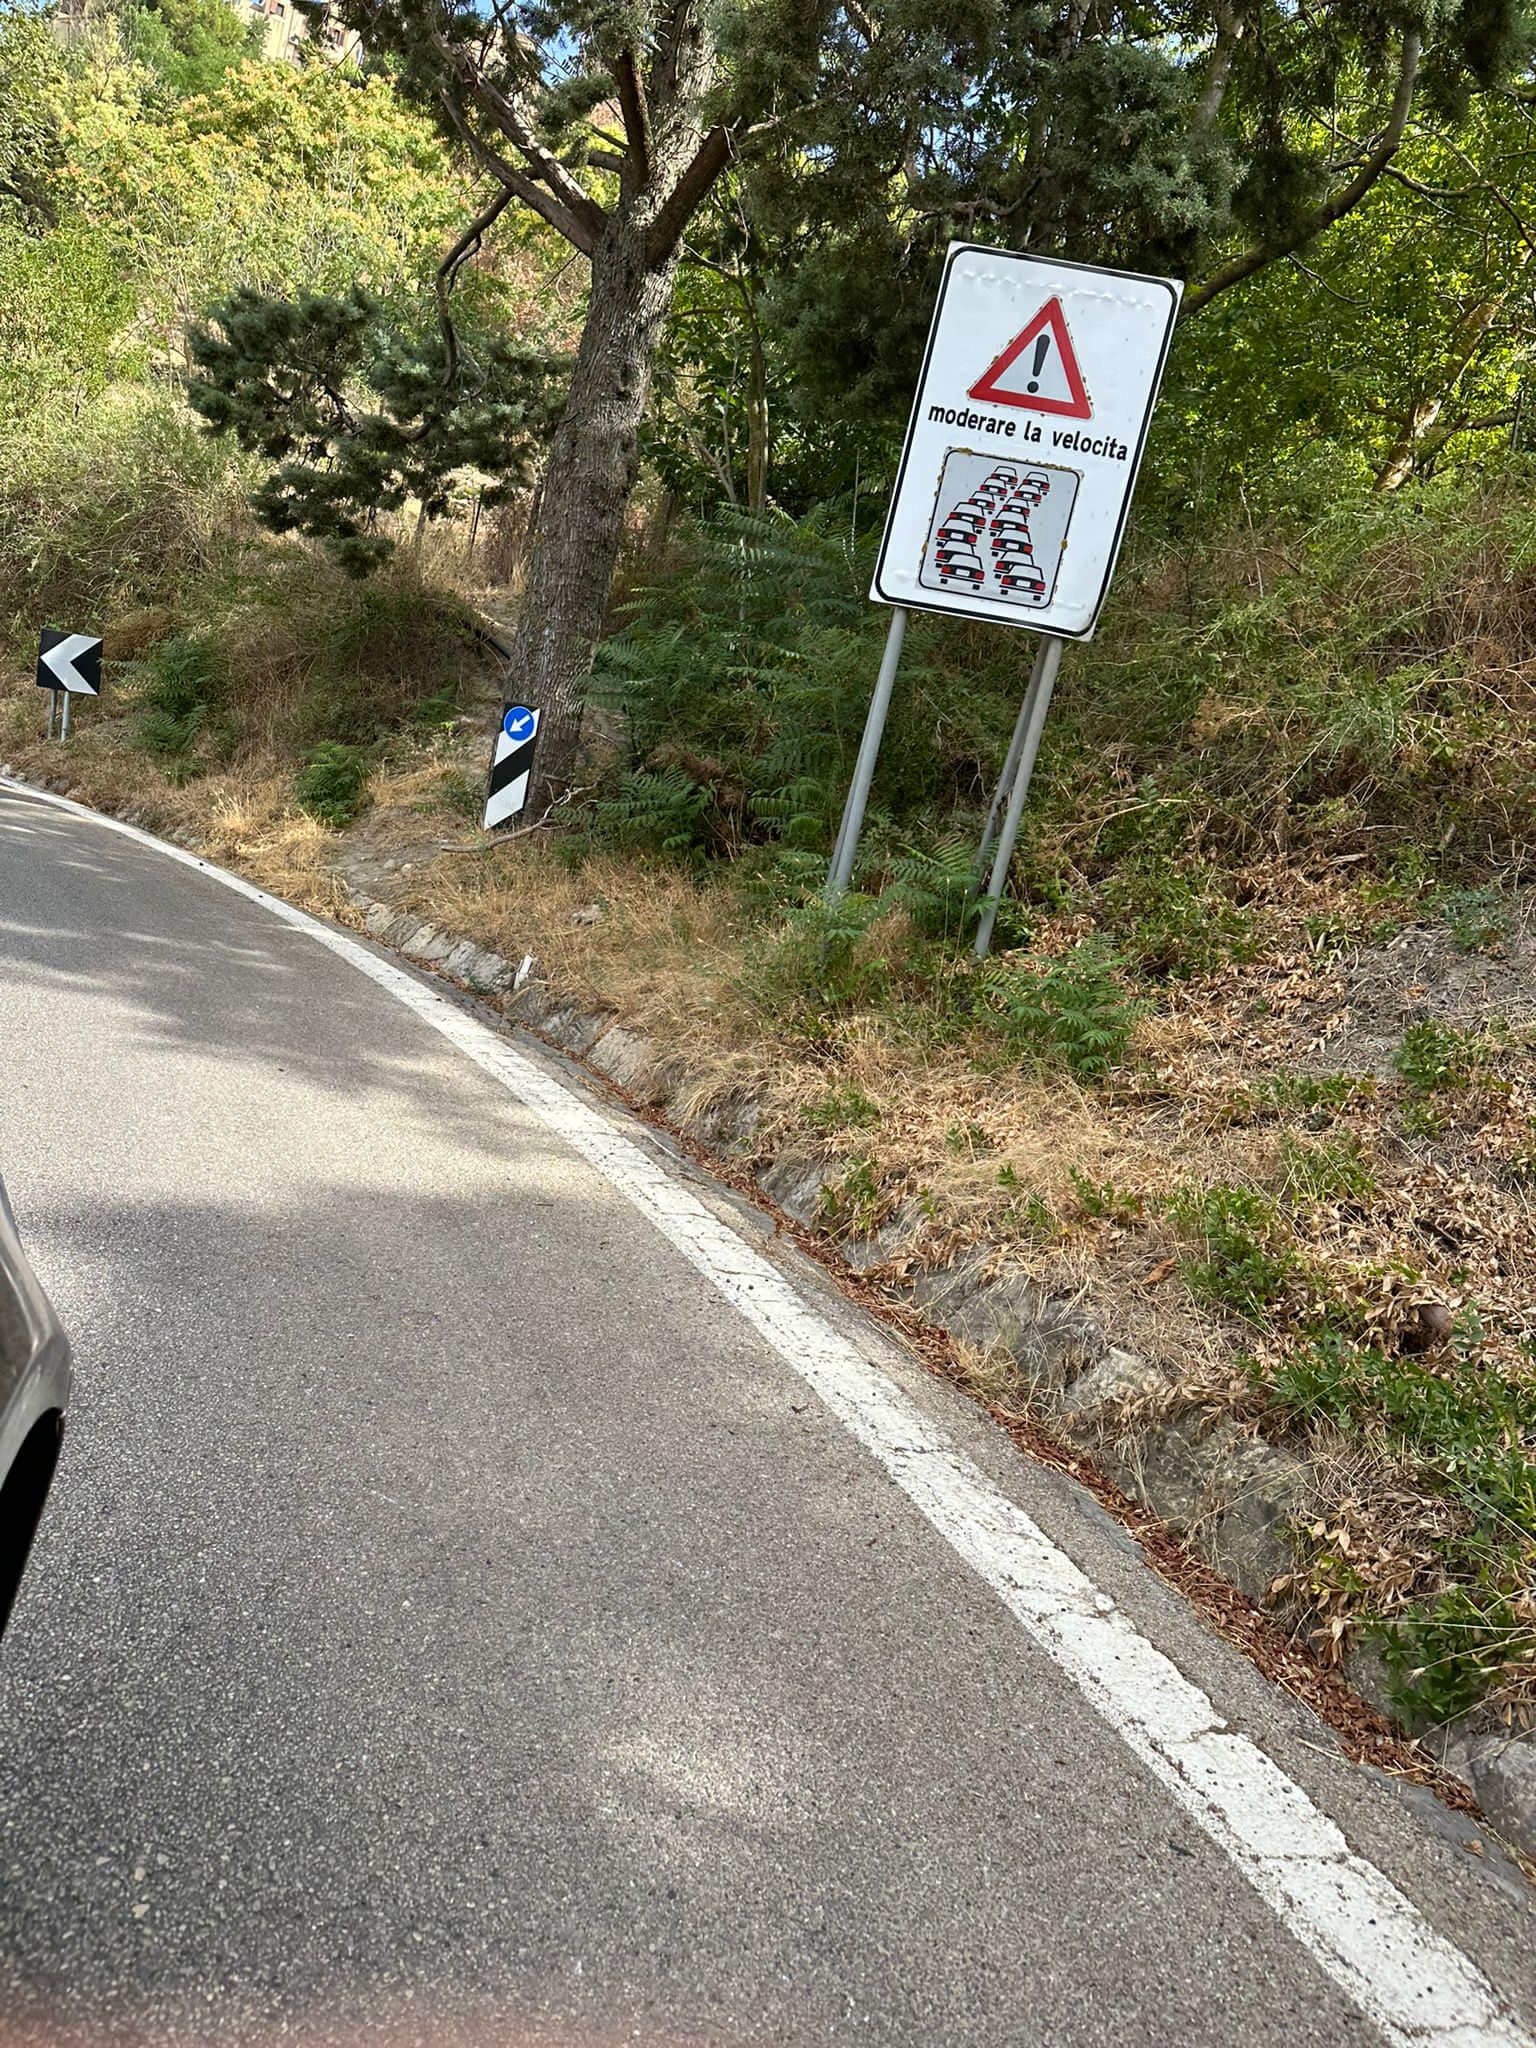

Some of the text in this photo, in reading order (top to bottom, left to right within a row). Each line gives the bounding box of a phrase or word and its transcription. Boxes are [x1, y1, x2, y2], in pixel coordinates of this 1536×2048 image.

[928, 405, 1128, 461] moderare la velocita
